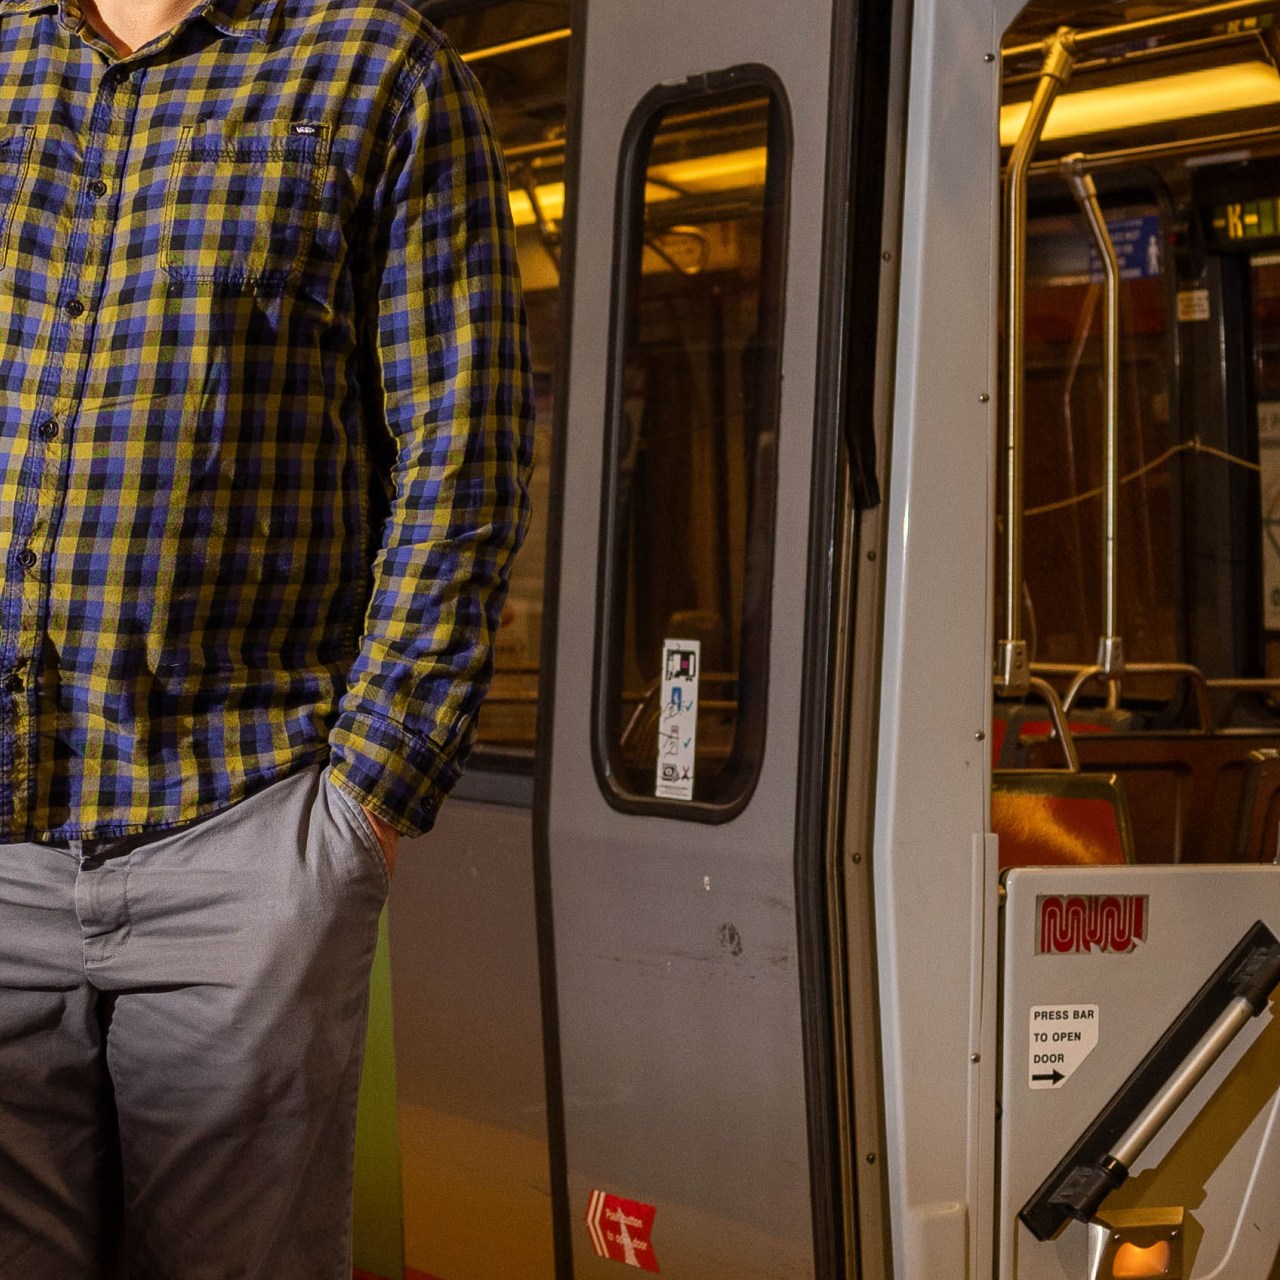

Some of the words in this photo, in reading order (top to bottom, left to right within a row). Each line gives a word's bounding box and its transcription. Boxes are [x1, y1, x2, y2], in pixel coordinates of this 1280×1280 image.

[1034, 1010, 1069, 1021] PRESS
[1072, 1009, 1095, 1020] BAR
[1033, 1032, 1048, 1043] TO
[1052, 1031, 1082, 1042] OPEN
[1033, 1053, 1065, 1064] DOOR
